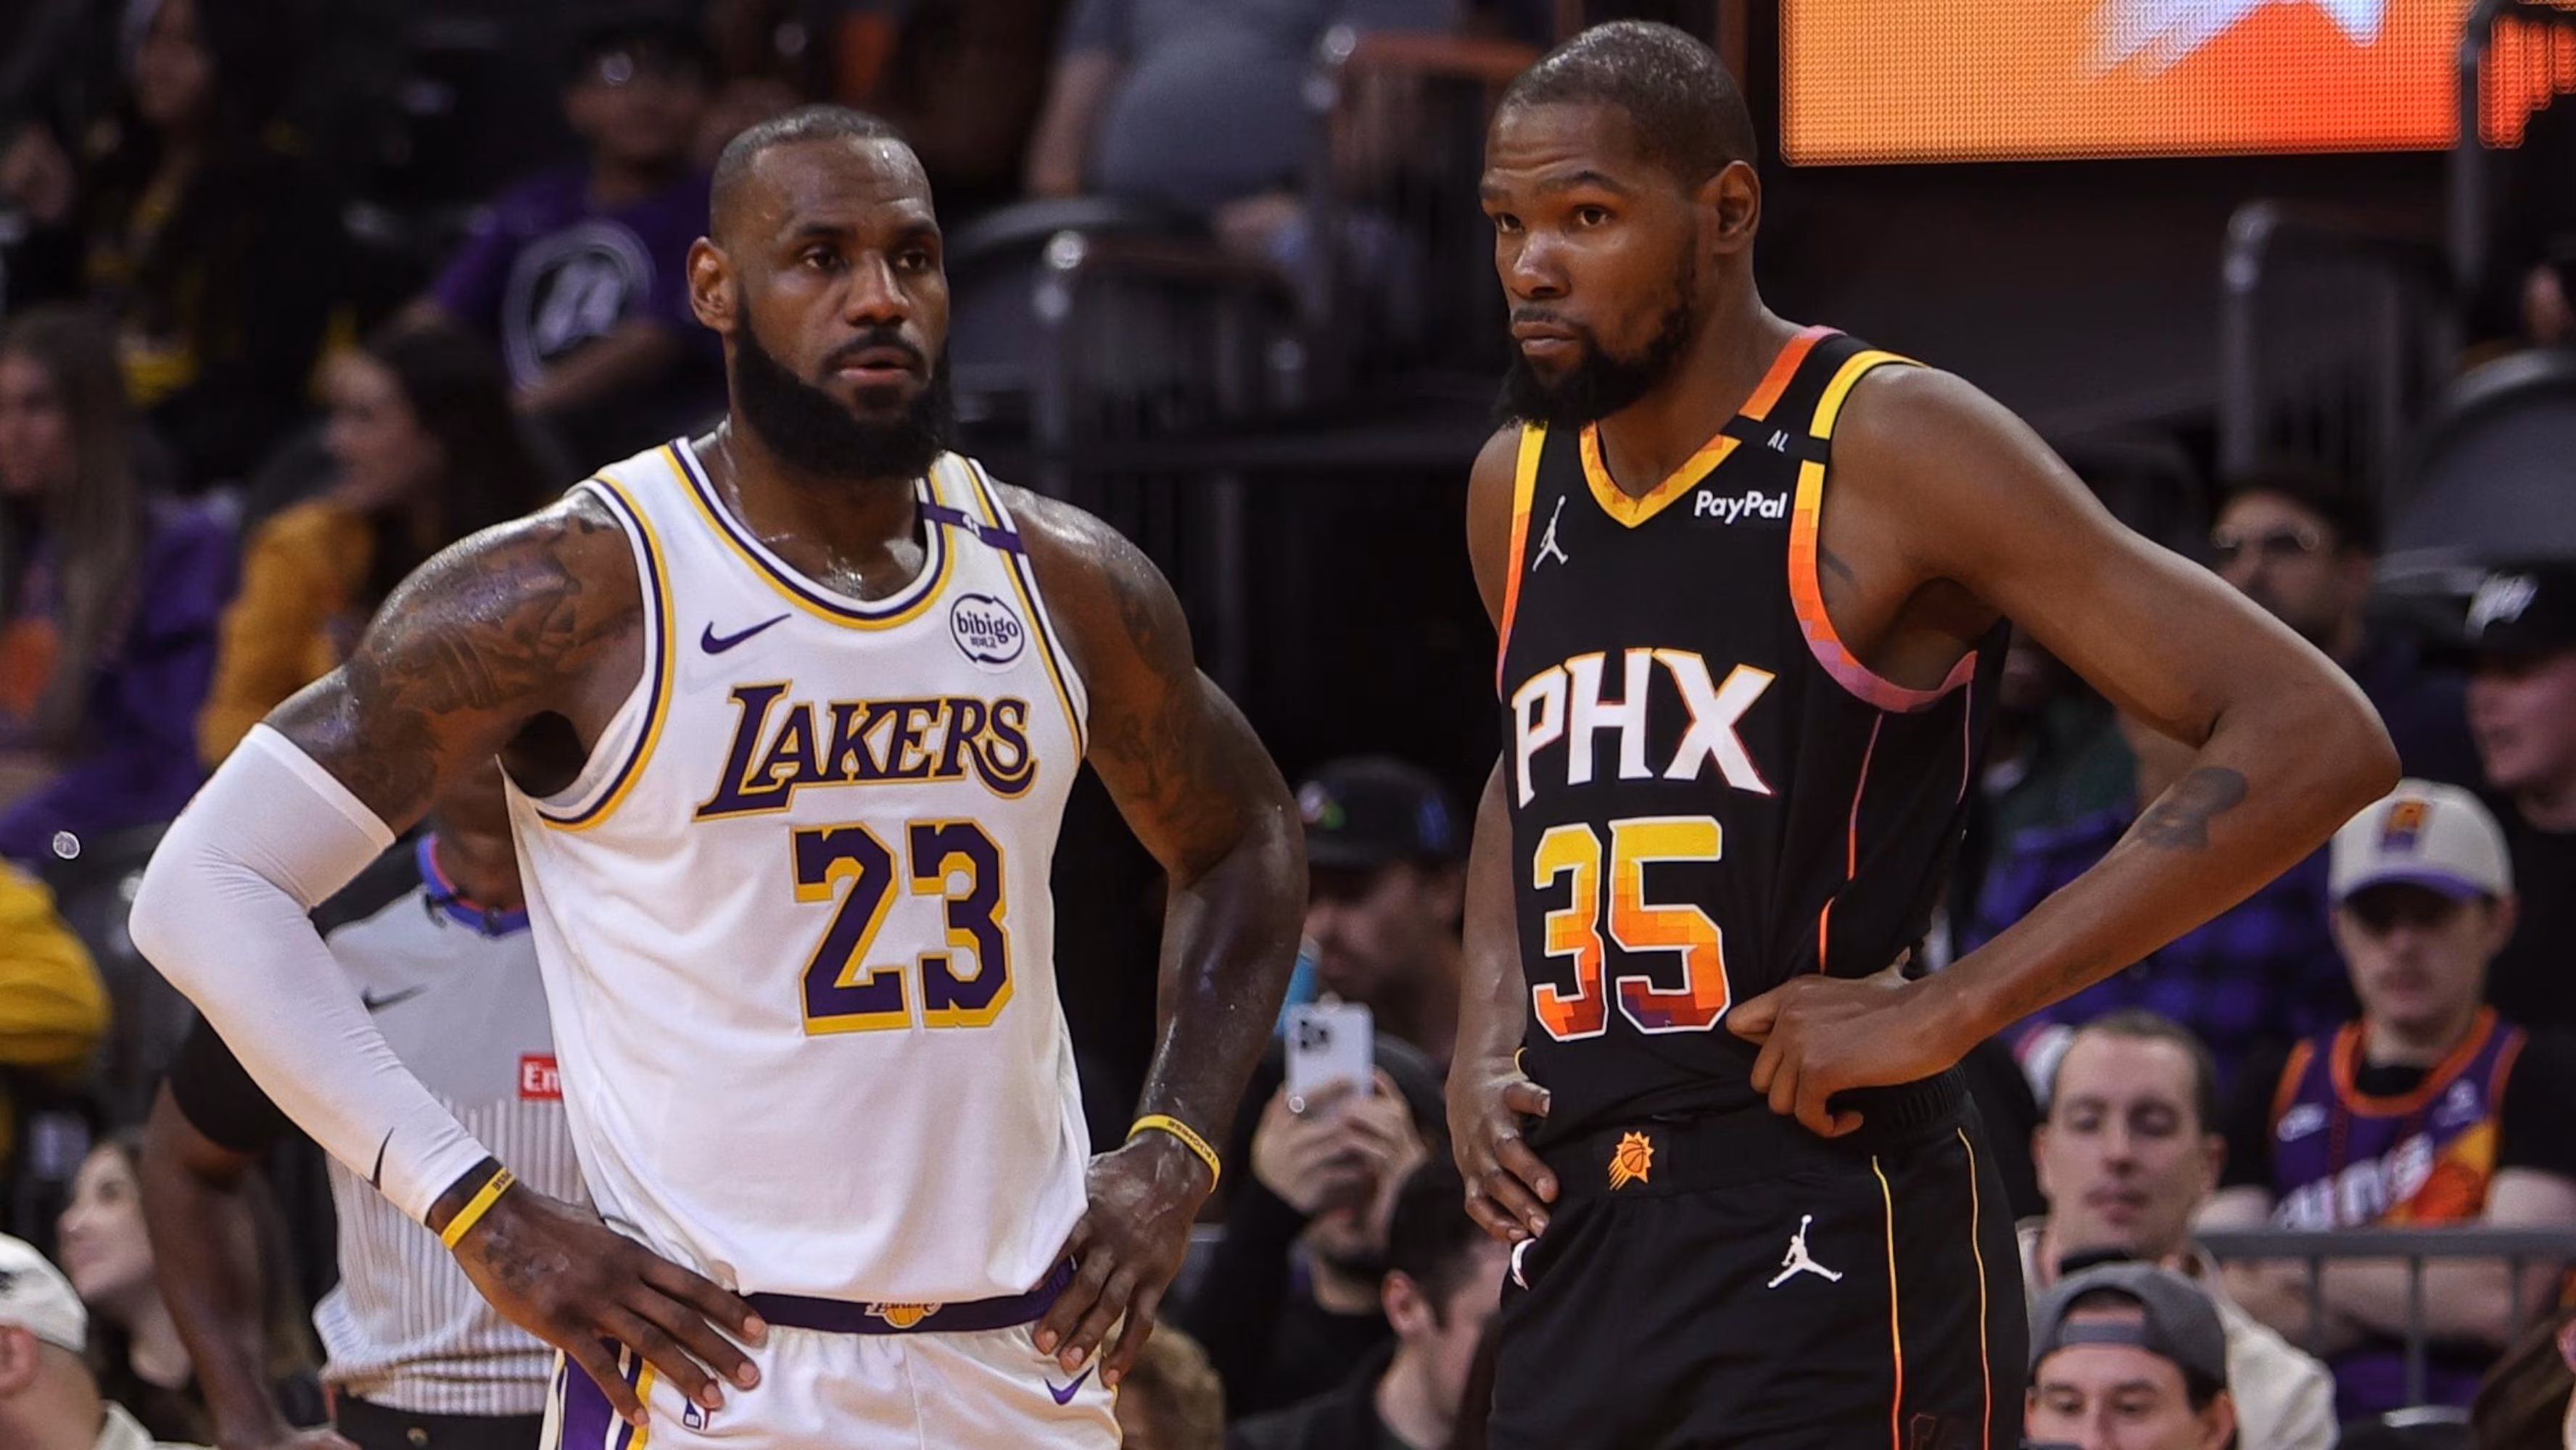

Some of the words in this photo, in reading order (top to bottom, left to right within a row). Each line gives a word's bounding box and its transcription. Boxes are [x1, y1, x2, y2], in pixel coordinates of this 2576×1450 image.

[1693, 490, 1788, 524] PayPal
[1767, 429, 1789, 452] AL
[956, 610, 1018, 644] bibigo
[691, 679, 1040, 822] LAKERS
[1511, 647, 1777, 809] PHX
[790, 816, 1014, 1037] 23
[1532, 815, 1731, 1042] 35
